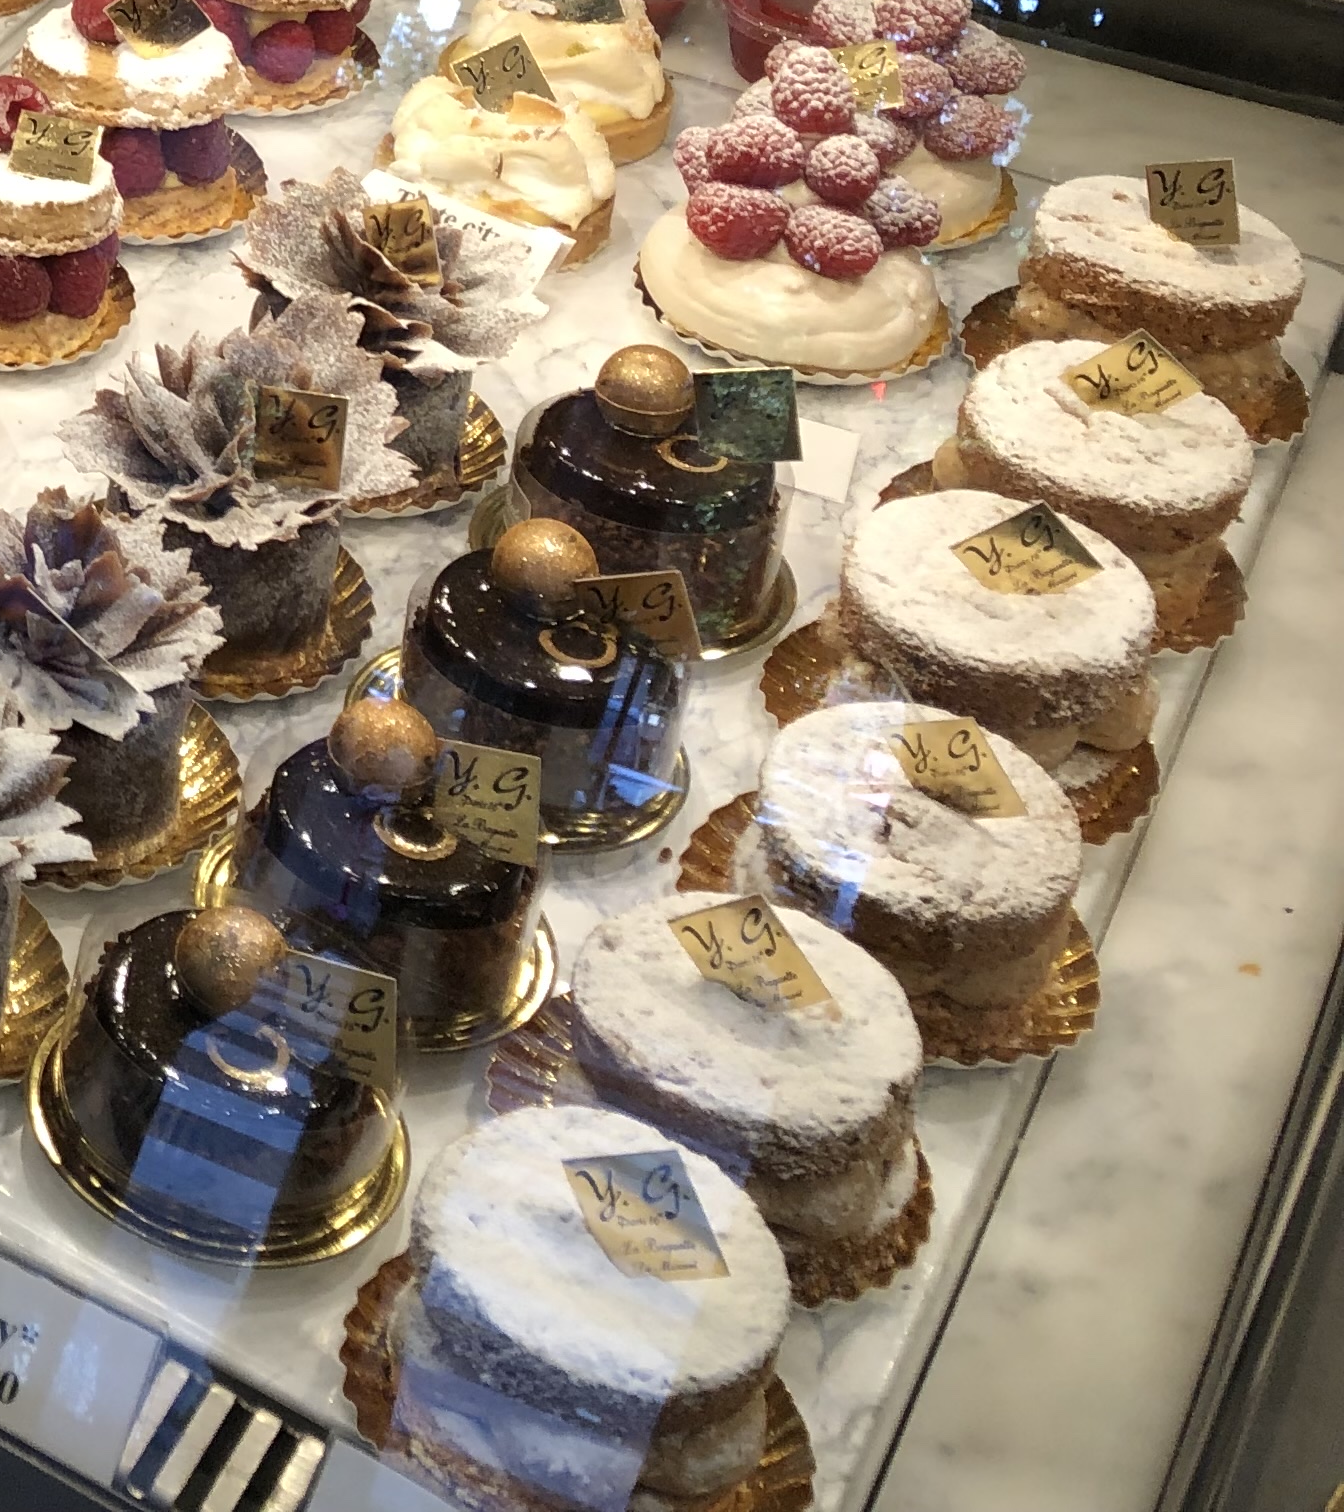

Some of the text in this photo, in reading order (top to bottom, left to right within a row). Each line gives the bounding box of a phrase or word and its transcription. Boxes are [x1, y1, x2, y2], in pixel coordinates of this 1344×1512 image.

[1152, 168, 1233, 207] Y. G.
[1073, 364, 1120, 400] Y.
[1126, 341, 1164, 376] G.
[962, 536, 1011, 577] Y.
[1021, 513, 1061, 552] G.
[587, 581, 683, 624] Y. G.
[446, 750, 533, 811] Y. G.
[891, 729, 988, 774] Y. G.
[681, 907, 782, 970] Y. G.
[297, 964, 390, 1033] Y. G.
[574, 1164, 691, 1222] Y. G.
